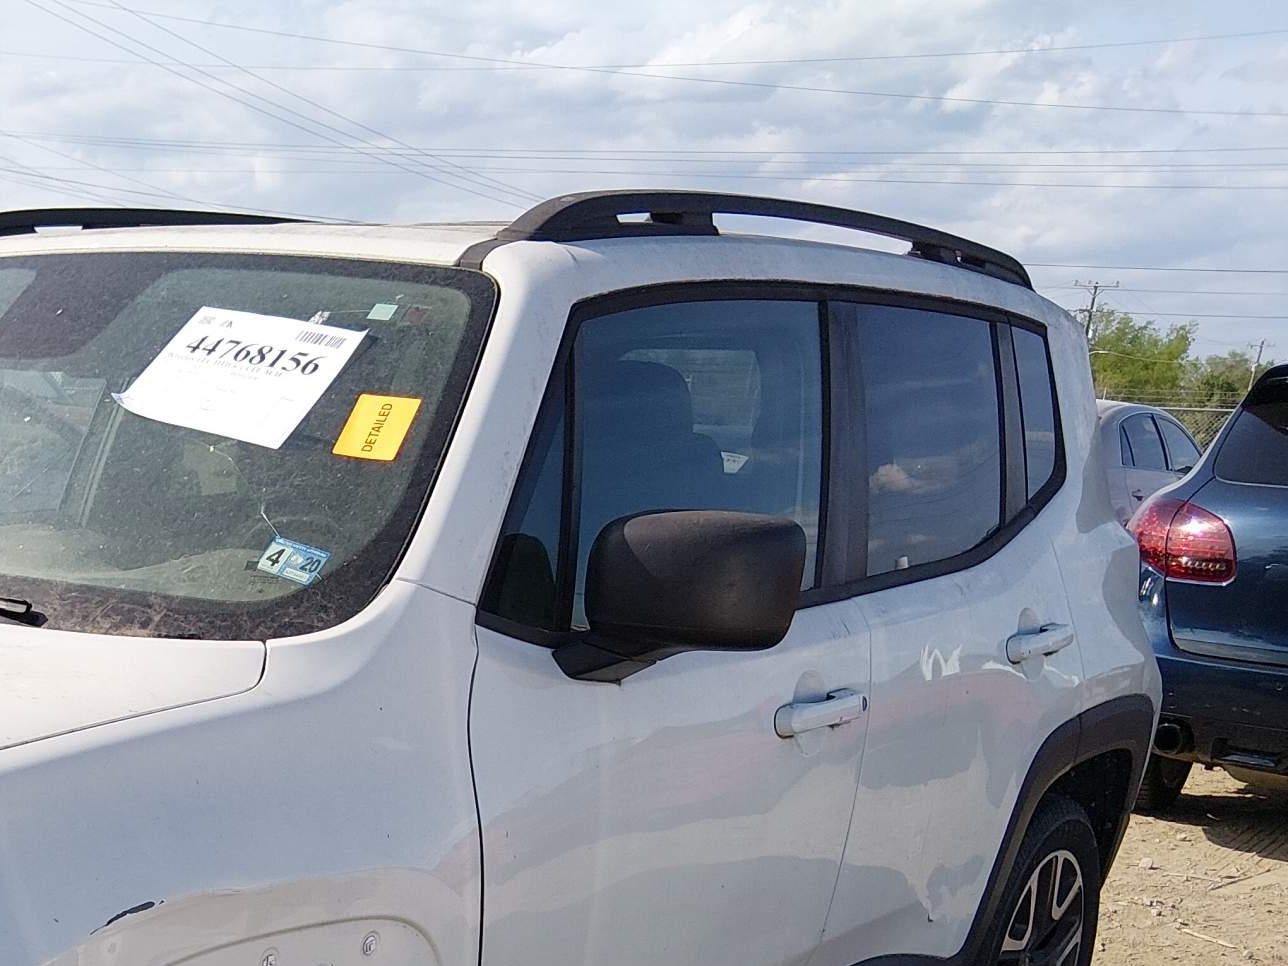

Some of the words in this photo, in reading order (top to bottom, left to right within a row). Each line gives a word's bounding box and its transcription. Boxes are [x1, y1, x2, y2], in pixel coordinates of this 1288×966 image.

[186, 334, 329, 376] 44768156
[361, 403, 393, 453] DETAILED
[265, 548, 286, 567] 4
[298, 556, 322, 574] 20
